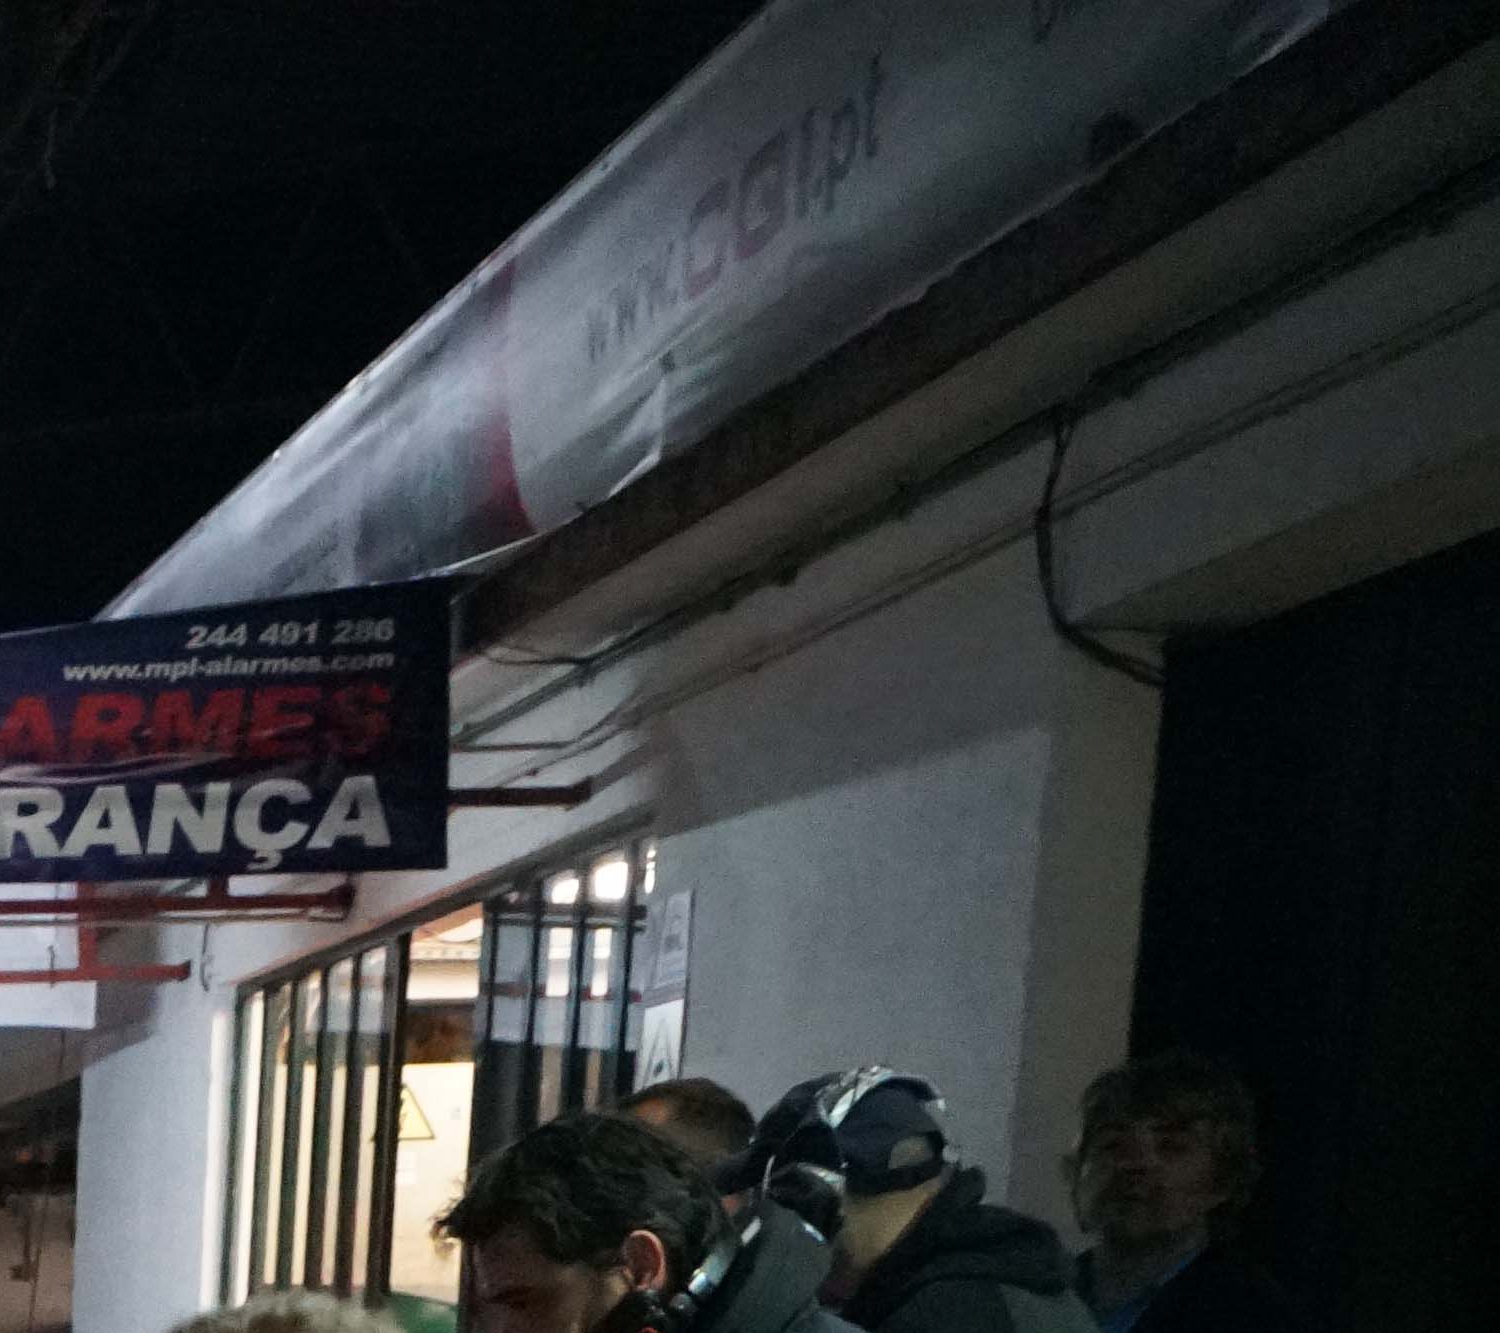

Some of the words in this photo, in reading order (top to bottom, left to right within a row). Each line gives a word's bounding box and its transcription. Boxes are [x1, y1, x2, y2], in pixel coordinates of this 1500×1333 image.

[185, 624, 248, 650] 244
[258, 621, 318, 648] 491
[61, 650, 396, 683] www.mpl-alarmes.com
